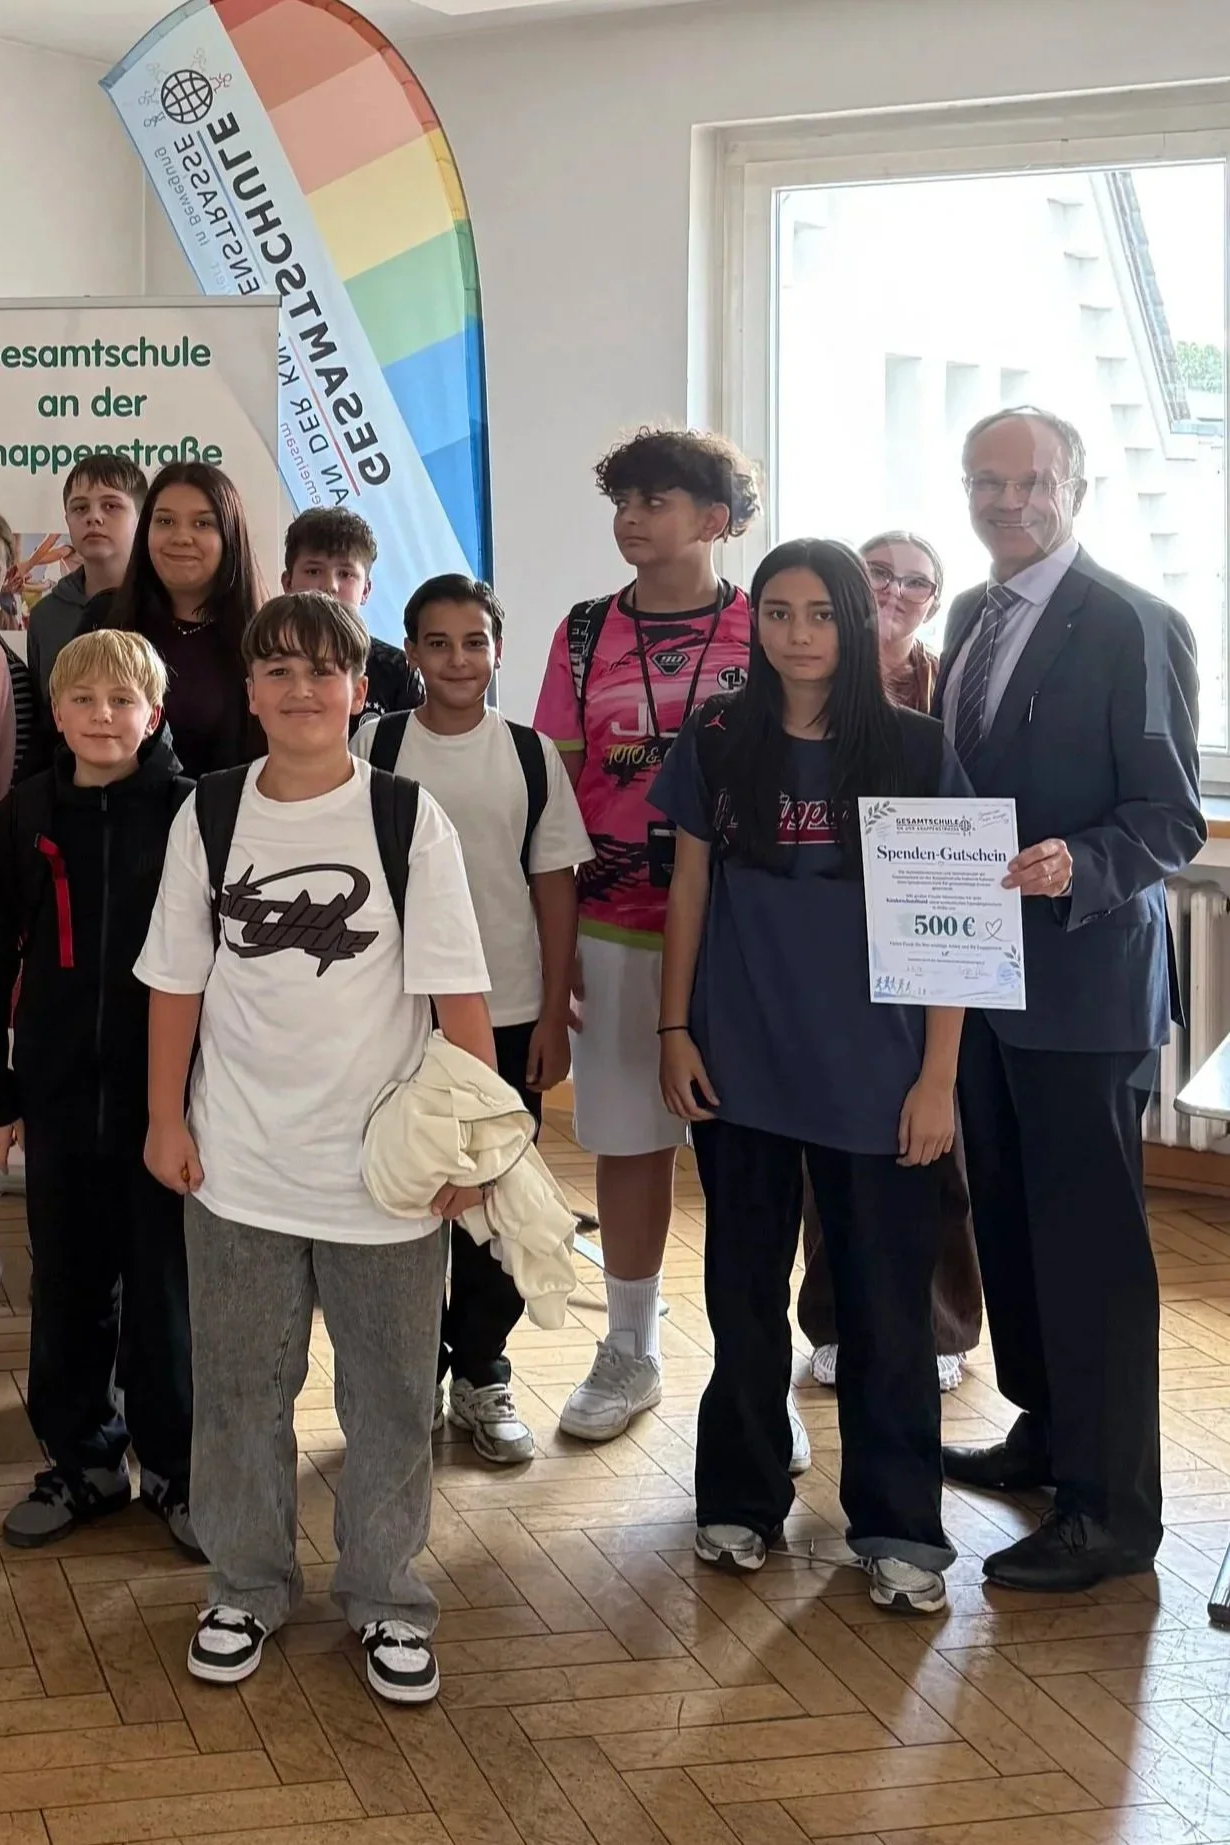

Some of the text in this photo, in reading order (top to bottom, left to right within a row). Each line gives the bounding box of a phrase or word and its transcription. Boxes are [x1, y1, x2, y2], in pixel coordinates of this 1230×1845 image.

[38, 386, 148, 417] an der
[896, 817, 959, 826] GESAMTSCHULE
[876, 845, 1007, 862] Spenden-Gutschein
[914, 914, 976, 937] 500 €
